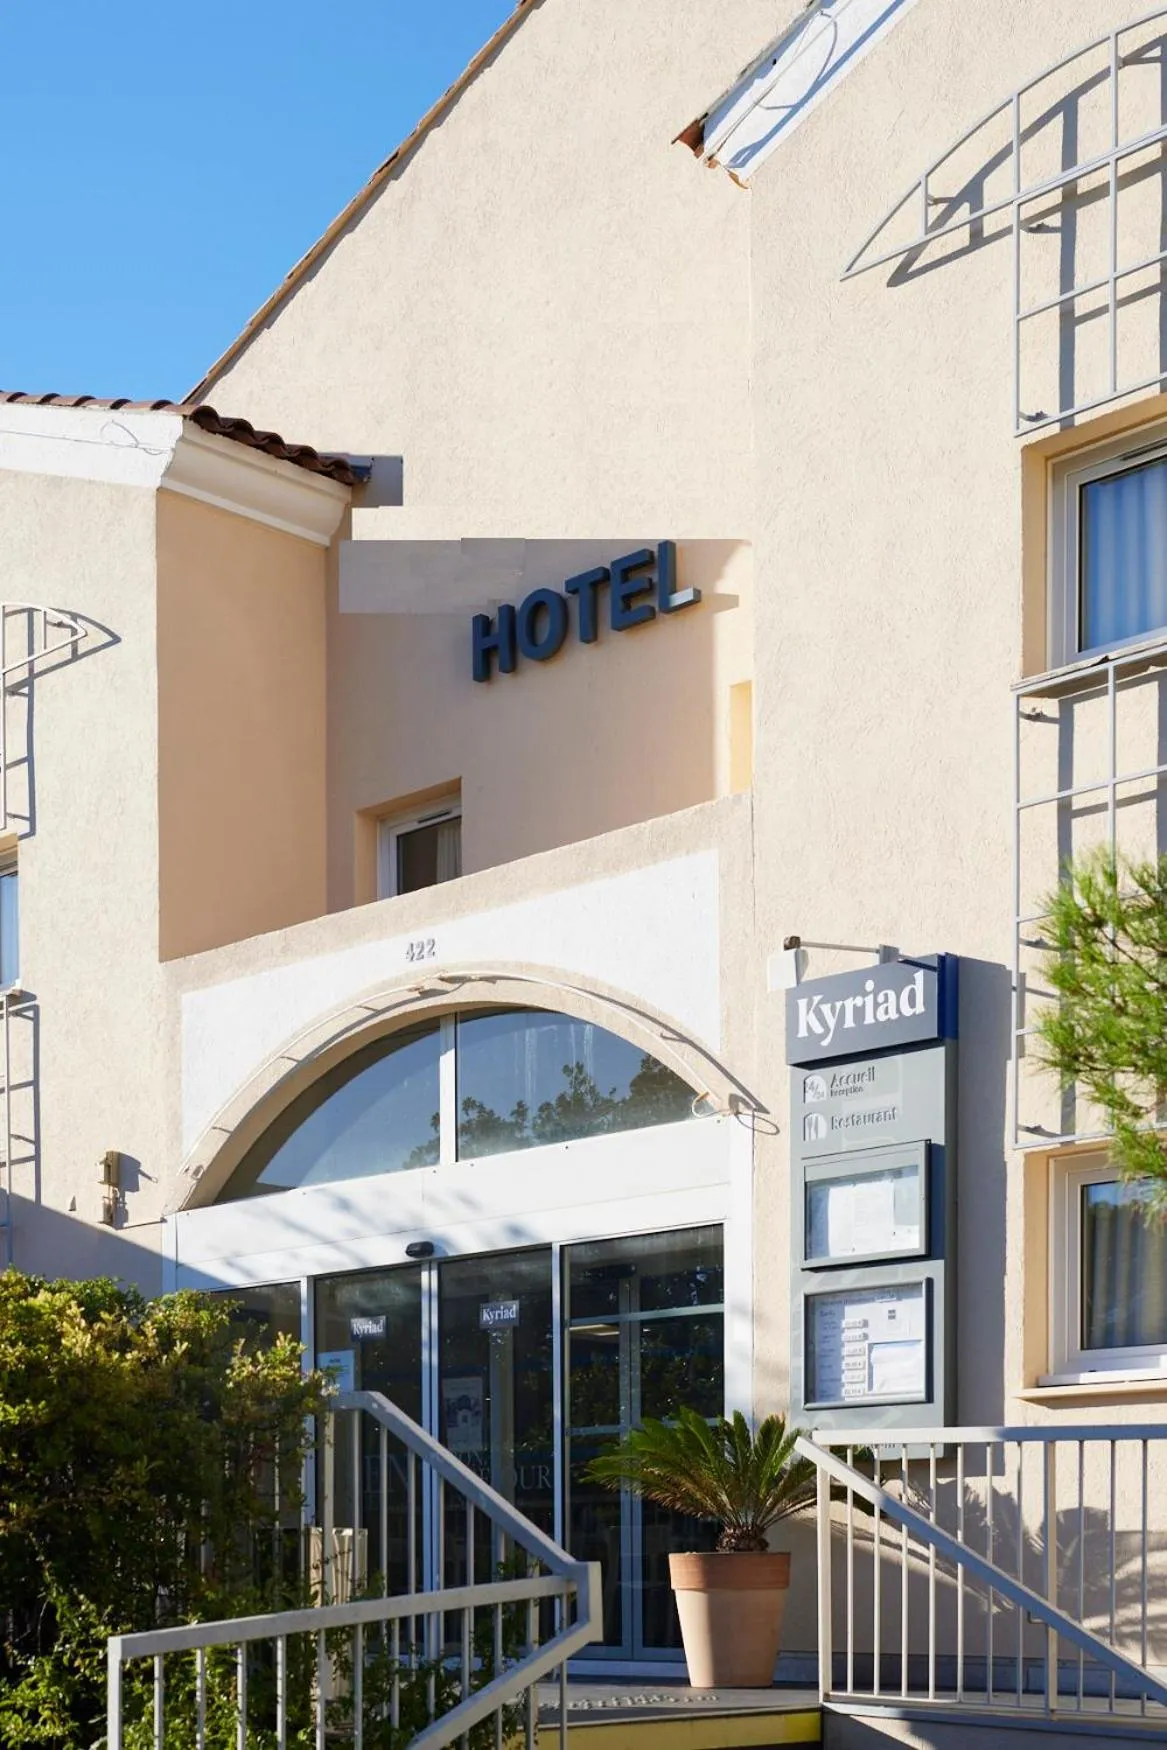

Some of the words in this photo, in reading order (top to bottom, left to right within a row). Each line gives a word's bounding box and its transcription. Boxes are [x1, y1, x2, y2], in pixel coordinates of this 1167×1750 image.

[472, 540, 701, 682] HOTEL
[406, 938, 435, 962] 422
[797, 969, 925, 1046] Kyriad
[830, 1066, 875, 1088] Accueil
[831, 1106, 896, 1130] Restaurant
[482, 1303, 516, 1324] Kyriad
[353, 1319, 383, 1337] Kyriad
